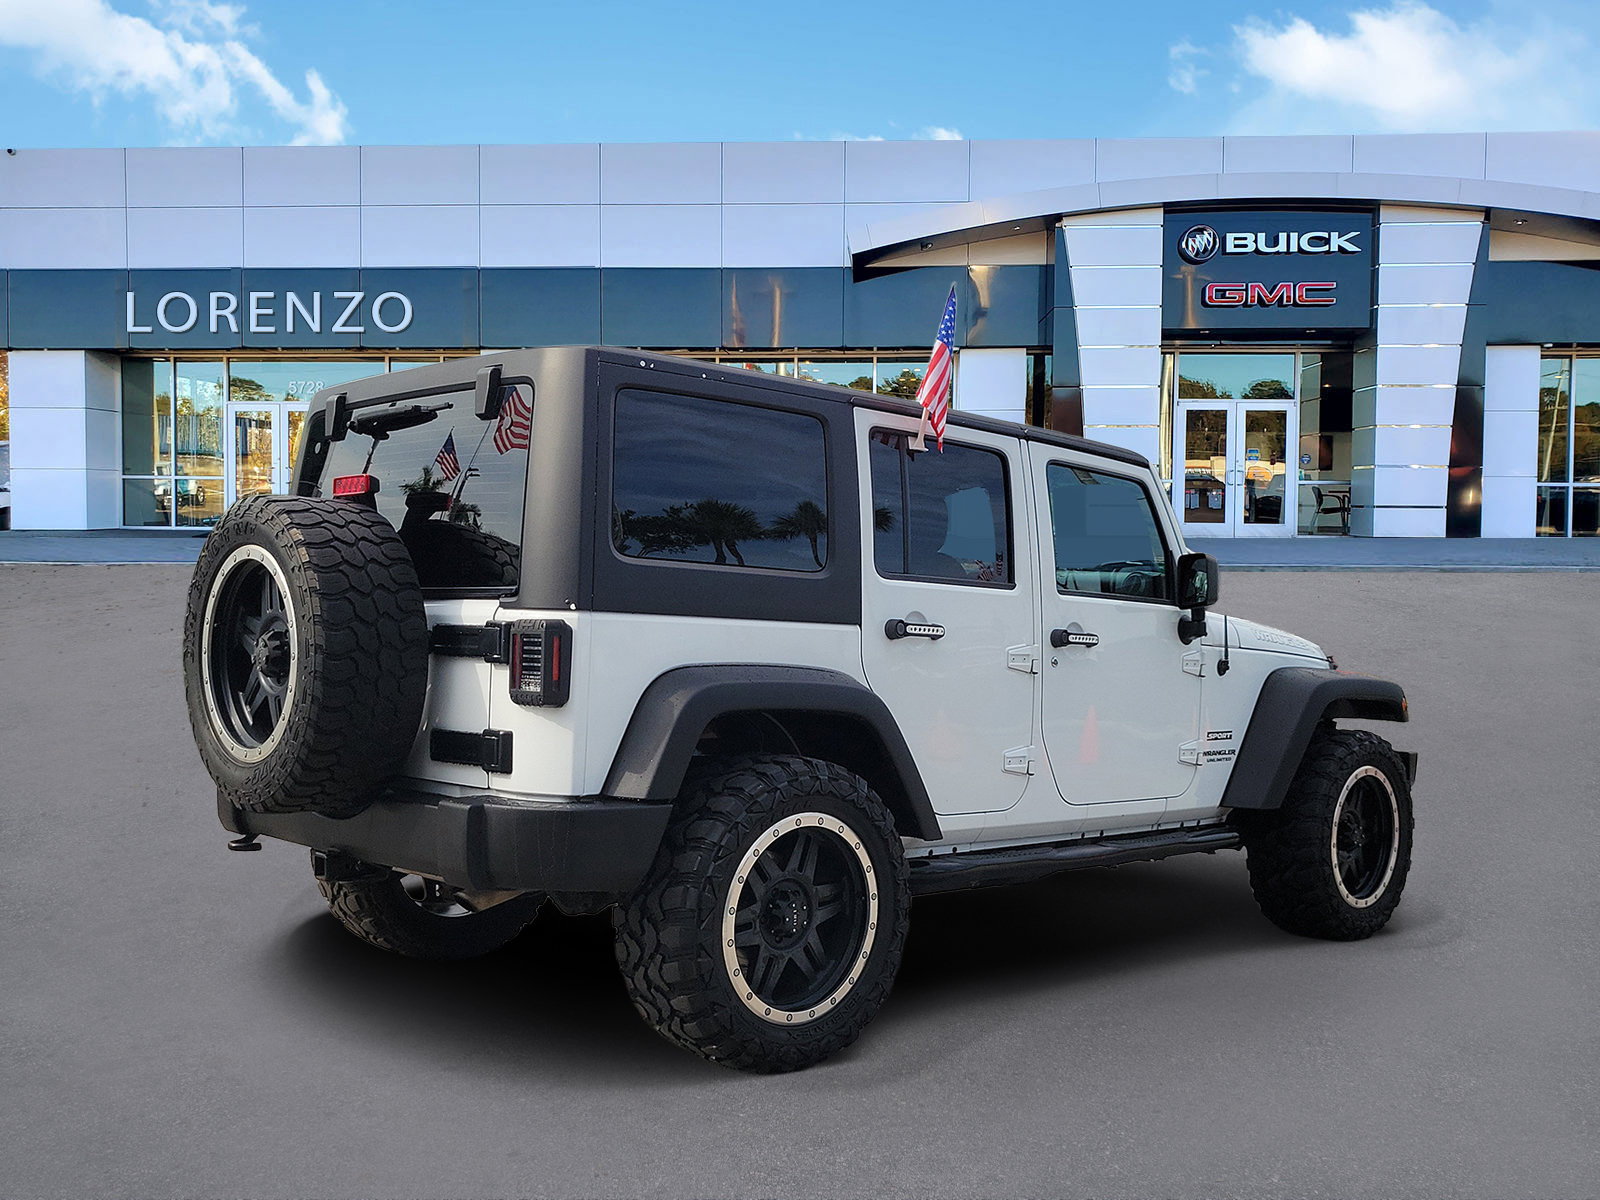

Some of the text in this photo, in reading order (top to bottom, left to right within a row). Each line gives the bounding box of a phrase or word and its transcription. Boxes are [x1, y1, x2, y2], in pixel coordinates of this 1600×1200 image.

[1226, 231, 1361, 254] BUICK
[1205, 281, 1337, 306] GMC
[126, 291, 414, 334] LORENZO
[288, 381, 324, 394] 5728
[1207, 731, 1232, 741] SPORT
[1202, 749, 1236, 757] WRANGLER
